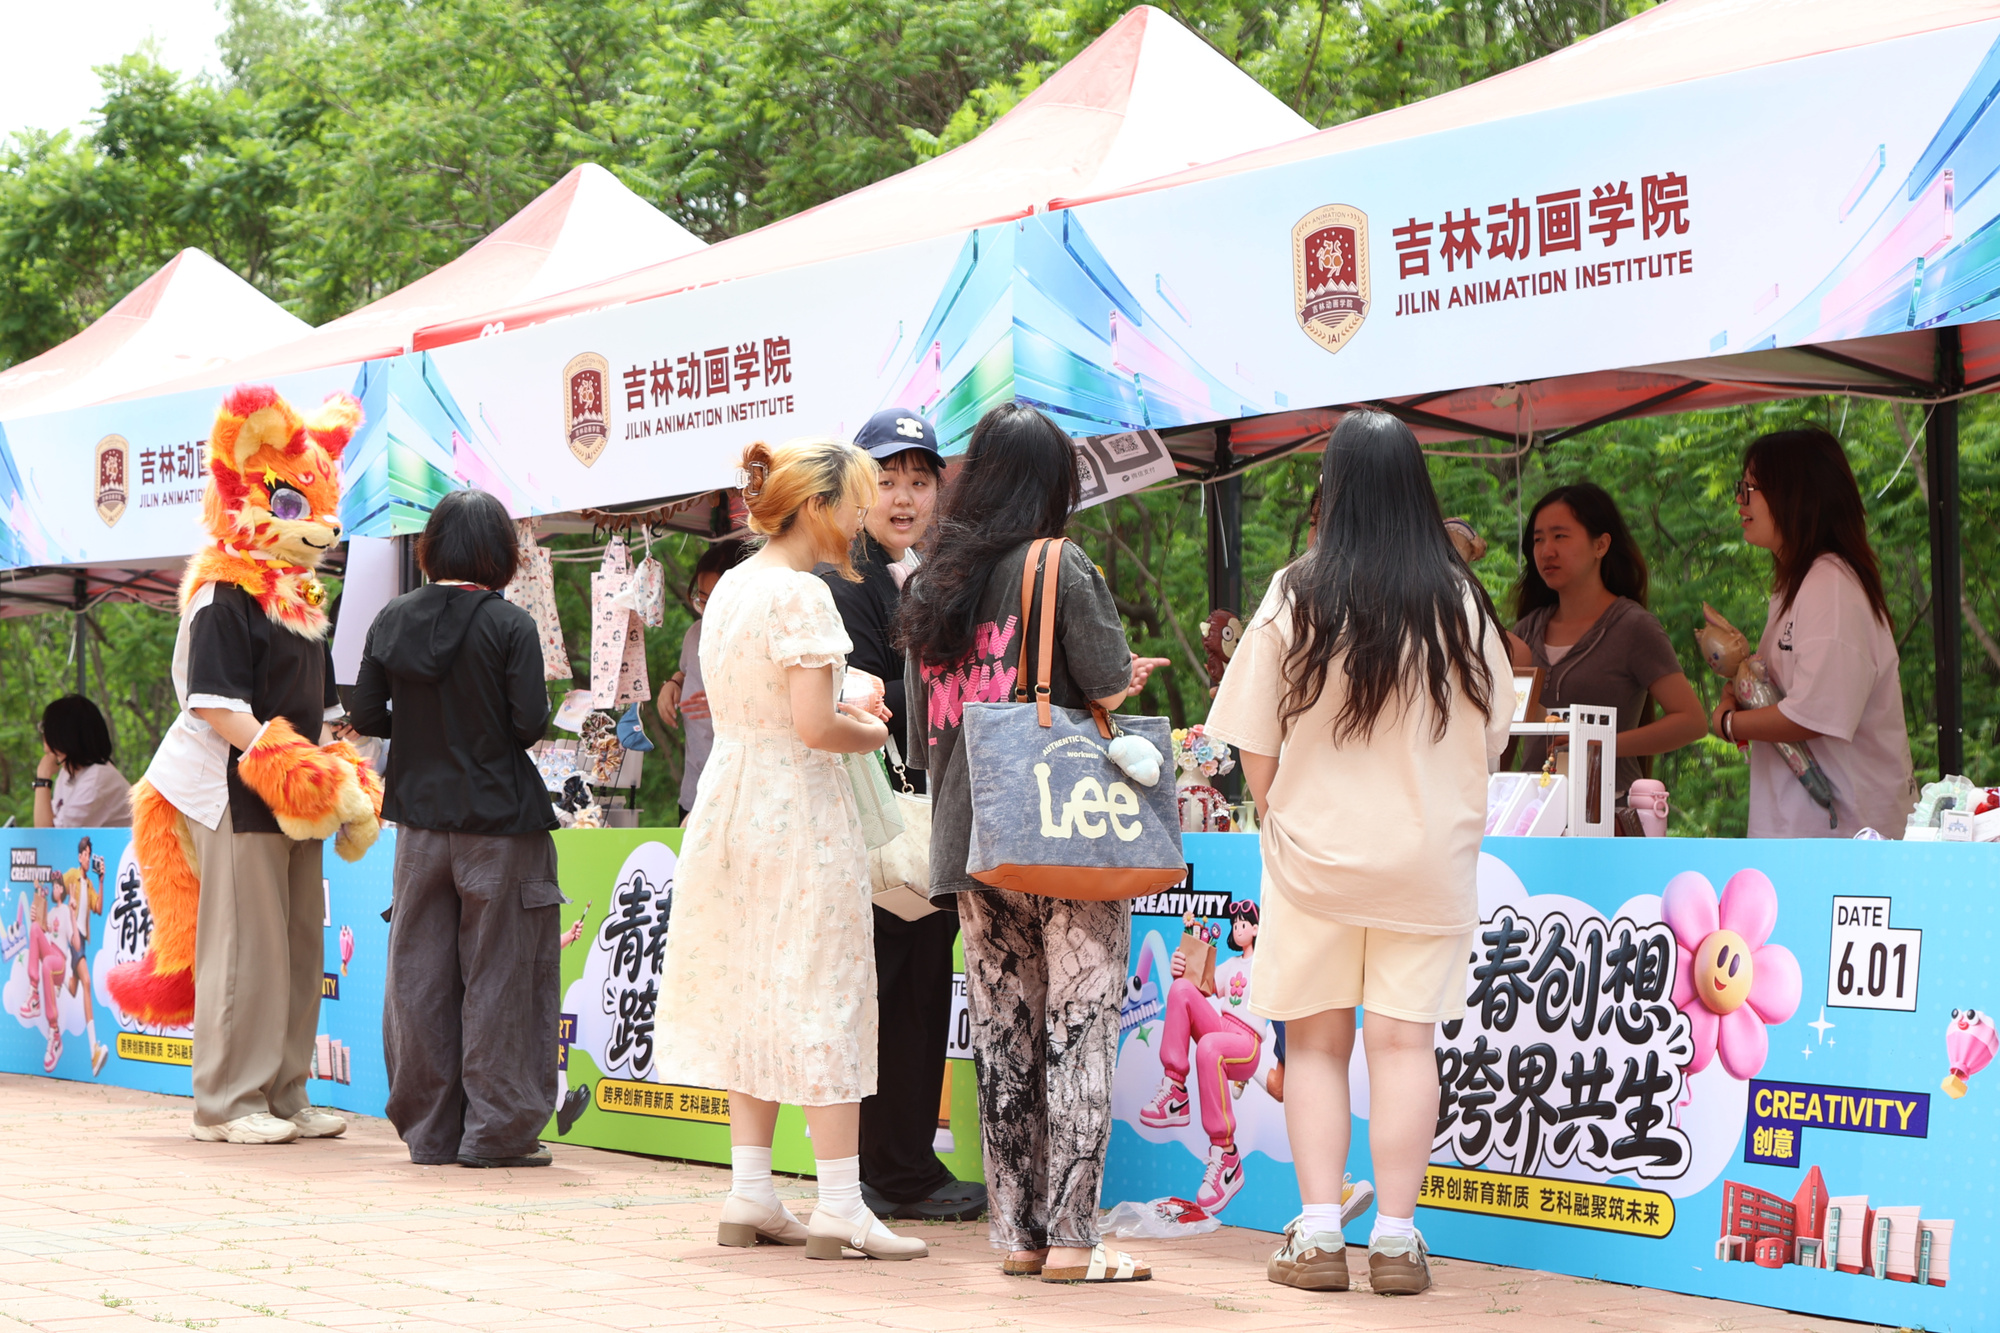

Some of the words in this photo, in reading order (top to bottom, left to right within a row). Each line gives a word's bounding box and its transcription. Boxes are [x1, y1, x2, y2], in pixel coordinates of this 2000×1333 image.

[1392, 172, 1690, 280] 吉林动画学院
[1395, 289, 1440, 317] JILIN
[1447, 268, 1567, 309] ANIMATION
[1575, 249, 1693, 290] INSTITUTE
[1327, 333, 1341, 344] JAI
[623, 335, 792, 412] 吉林动画学院
[625, 419, 651, 440] JILIN
[655, 407, 722, 435] ANIMATION
[727, 395, 794, 423] INSTITUTE
[139, 492, 159, 508] JILIN
[162, 488, 206, 506] ANIMATIO
[1042, 735, 1080, 757] AUTHENTIC
[1033, 762, 1143, 842] Lee
[11, 850, 36, 865] YOUTH
[11, 866, 52, 882] CREATIVITY
[1837, 906, 1883, 927] DATE
[952, 981, 968, 996] TE
[1441, 916, 1671, 1045] 春创想
[1837, 941, 1908, 999] 6.01
[603, 1086, 674, 1110] 跨界创新育新质
[1434, 1034, 1683, 1175] 跨界共生
[1754, 1088, 1917, 1130] CREATIVITY
[1753, 1125, 1795, 1159] 创意
[1539, 1187, 1660, 1226] 艺科融聚筑未来
